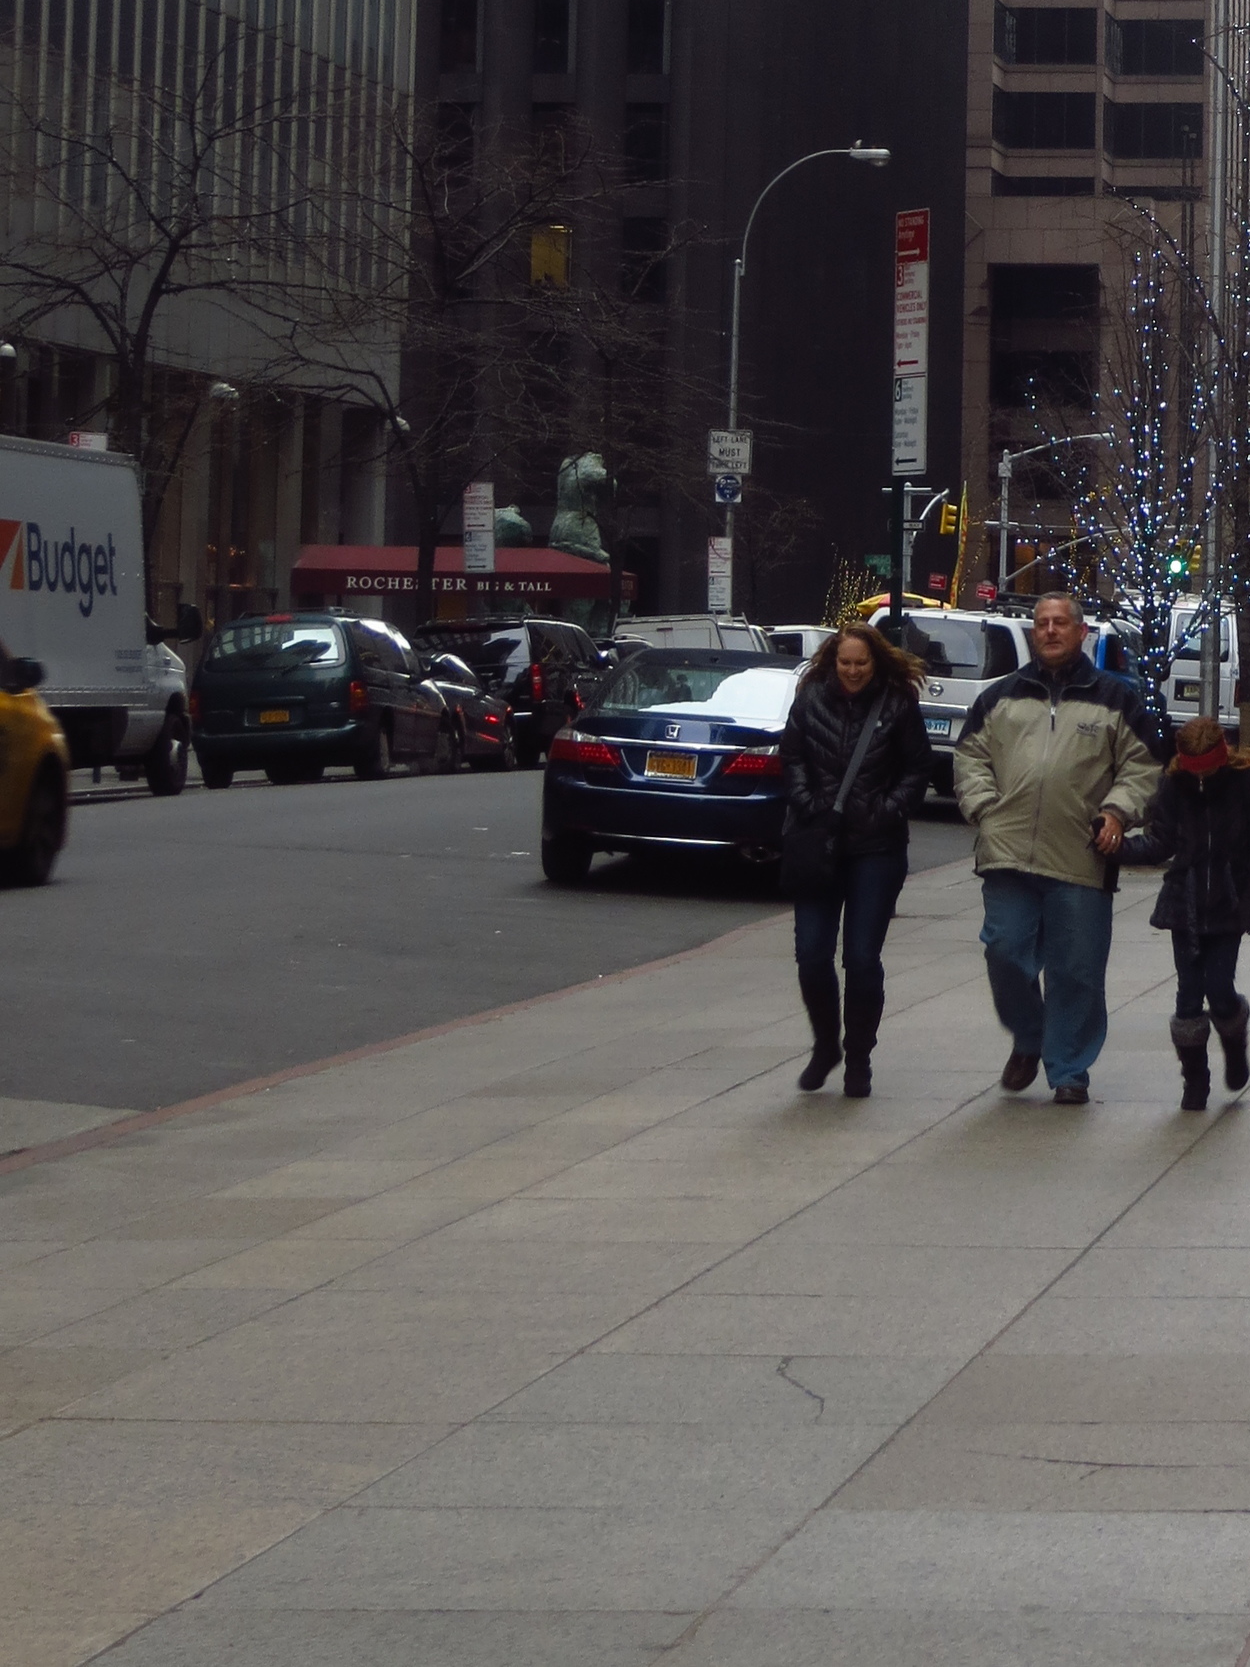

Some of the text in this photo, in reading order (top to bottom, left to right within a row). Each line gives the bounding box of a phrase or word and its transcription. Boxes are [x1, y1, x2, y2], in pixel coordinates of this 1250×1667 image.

[71, 434, 79, 445] 3
[712, 435, 728, 443] LEFT
[718, 448, 741, 456] MUST
[27, 521, 117, 617] Budget
[346, 575, 467, 591] ROCHETER
[504, 580, 514, 590] &
[518, 580, 552, 590] TALL
